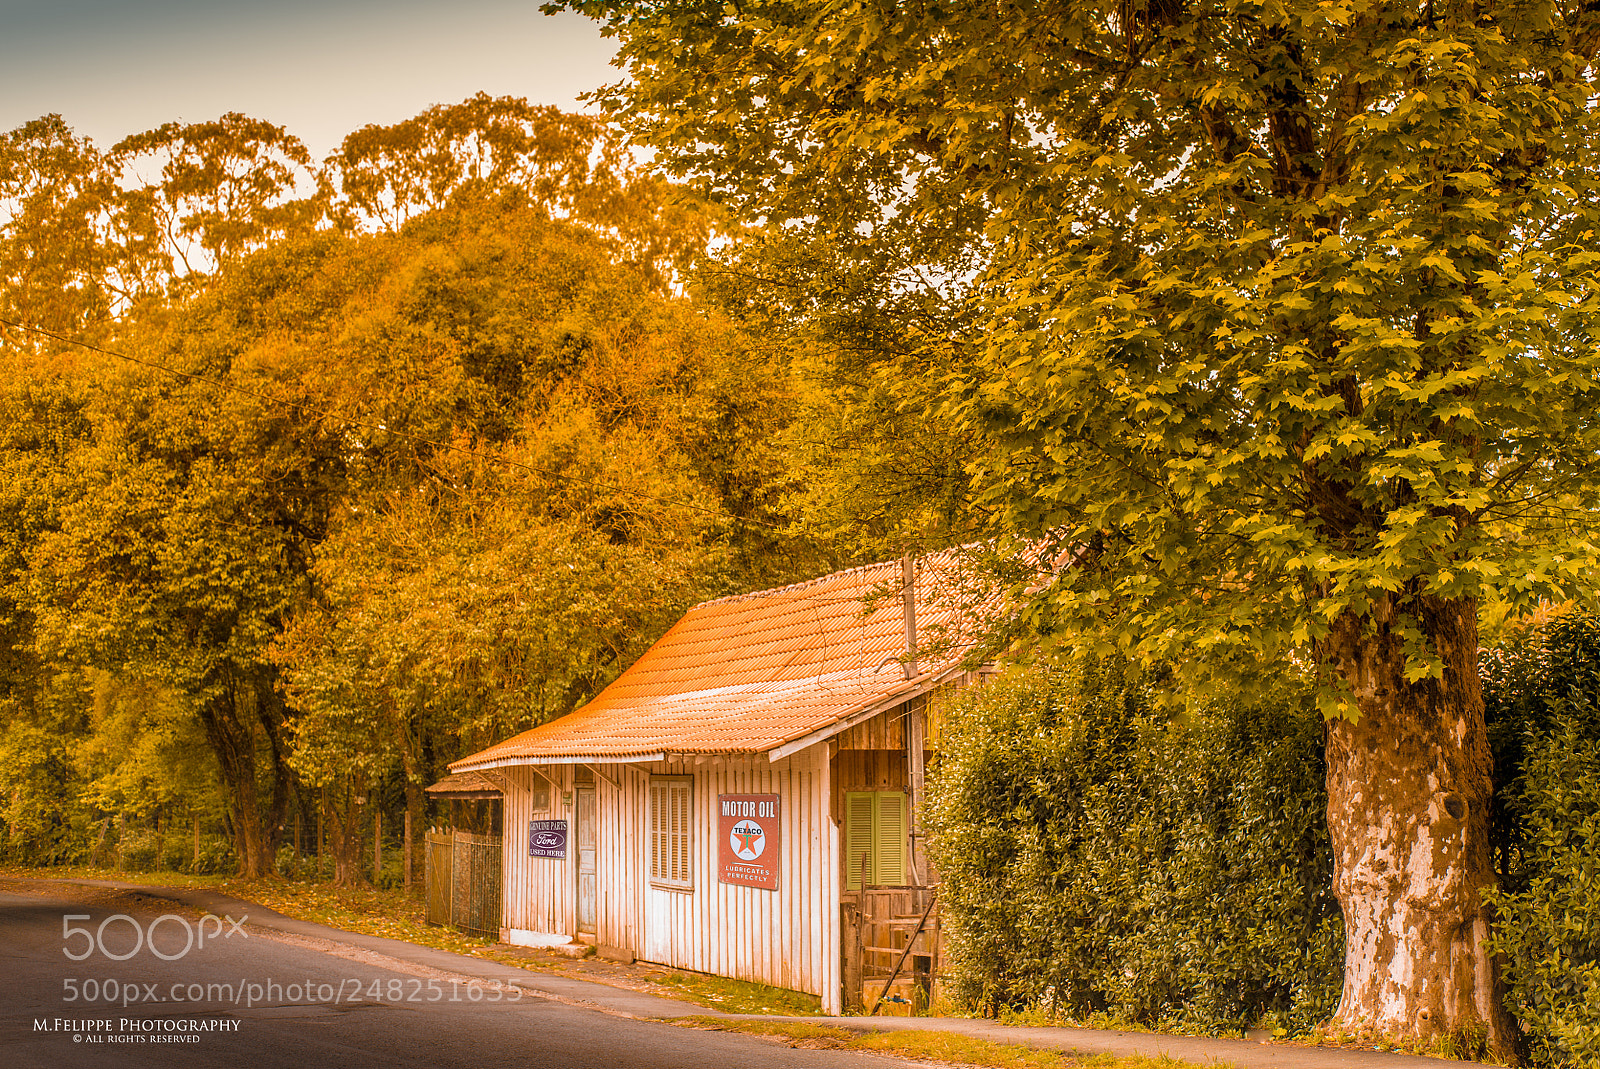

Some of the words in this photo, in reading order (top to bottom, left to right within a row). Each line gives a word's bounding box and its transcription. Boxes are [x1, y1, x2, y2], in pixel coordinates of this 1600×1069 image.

[722, 800, 756, 818] MOTOR
[759, 801, 775, 818] OIL
[550, 821, 567, 831] PARTS
[734, 827, 762, 835] TEXACO
[536, 833, 558, 845] Ford
[546, 850, 565, 858] HERE
[725, 865, 770, 876] LUBRICATES
[727, 872, 768, 882] PERFECTLY
